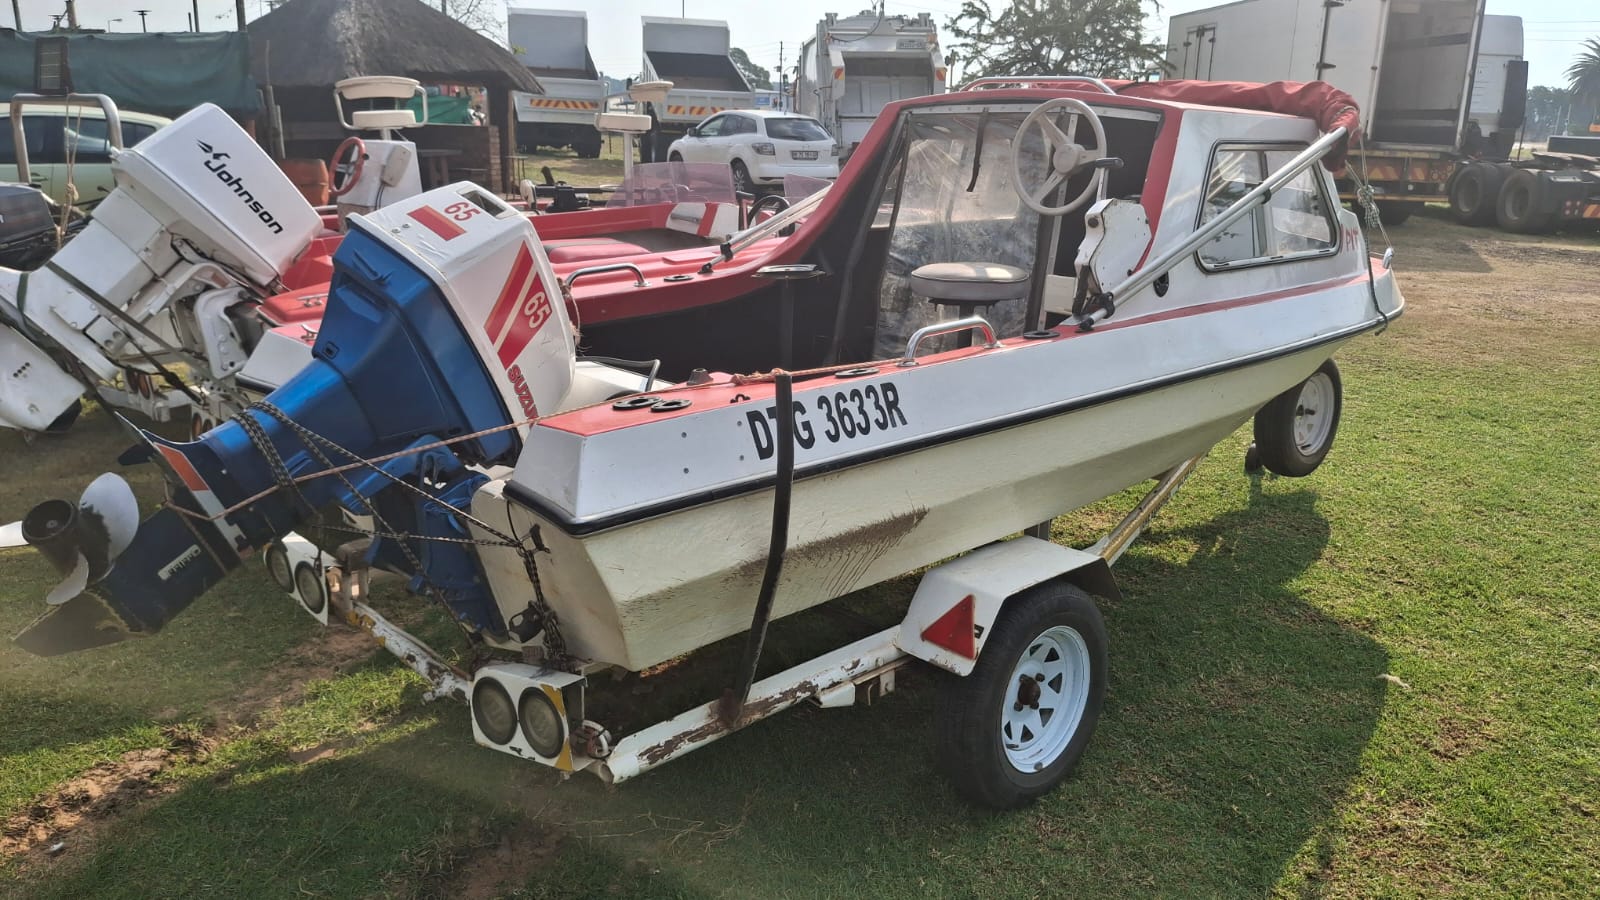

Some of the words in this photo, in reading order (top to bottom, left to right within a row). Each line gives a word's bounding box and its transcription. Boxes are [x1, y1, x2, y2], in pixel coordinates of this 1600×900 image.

[204, 160, 283, 235] Johnson
[444, 201, 481, 222] 65
[524, 291, 551, 329] 65
[746, 400, 816, 460] DG
[817, 382, 908, 443] 3633R
